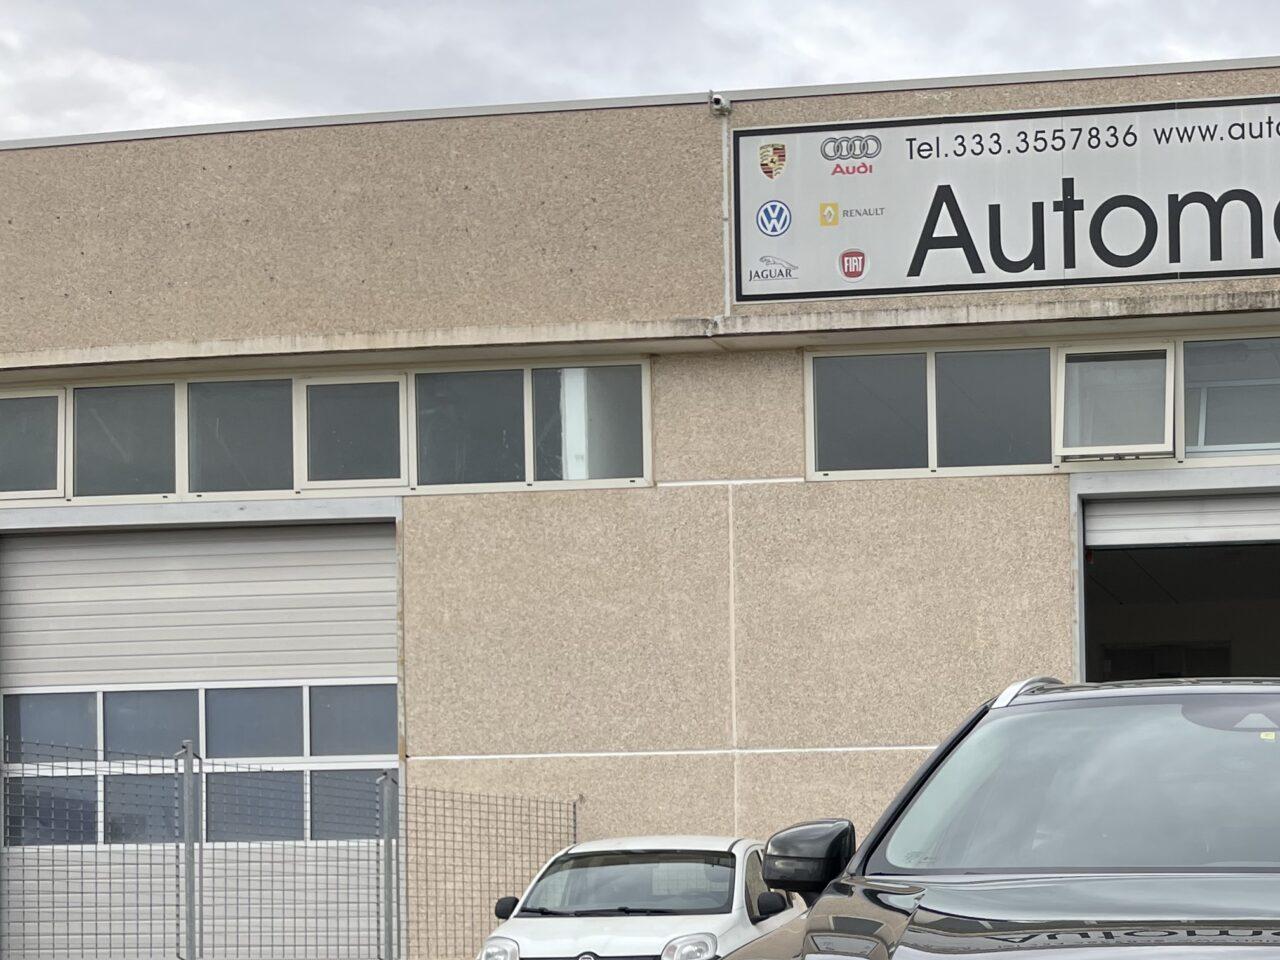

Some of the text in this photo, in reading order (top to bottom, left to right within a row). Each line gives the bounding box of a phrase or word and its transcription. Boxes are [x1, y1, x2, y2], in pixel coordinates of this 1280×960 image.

[831, 163, 873, 175] Audi
[842, 207, 886, 218] RENAULT
[844, 256, 863, 272] FIAT
[749, 268, 793, 282] JAGUAR
